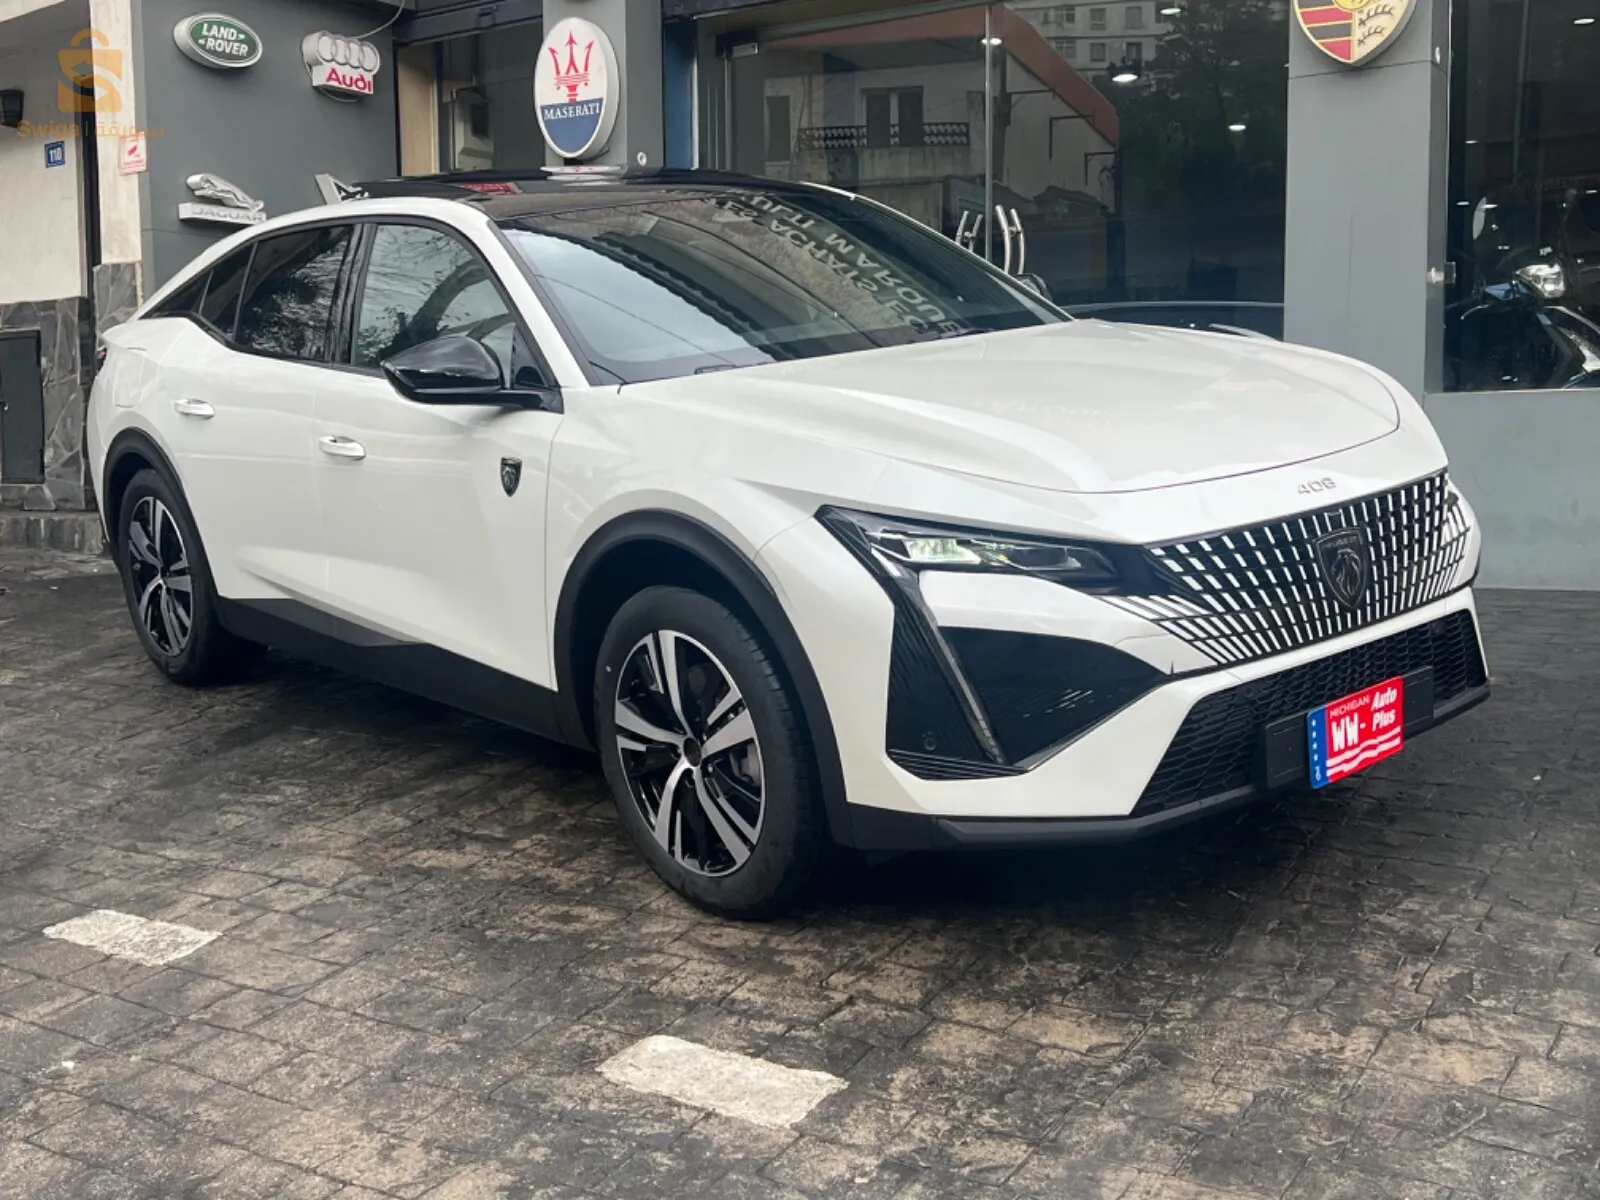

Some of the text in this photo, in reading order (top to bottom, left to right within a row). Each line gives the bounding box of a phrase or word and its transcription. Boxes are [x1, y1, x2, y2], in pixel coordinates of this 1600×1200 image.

[202, 23, 238, 40] LAND
[206, 38, 249, 57] ROVER
[325, 68, 373, 93] Audi
[544, 102, 600, 120] MASERATI
[191, 207, 265, 222] JAGUAR
[1298, 477, 1337, 495] 408
[1371, 687, 1398, 711] Auto
[1372, 709, 1396, 732] Plus
